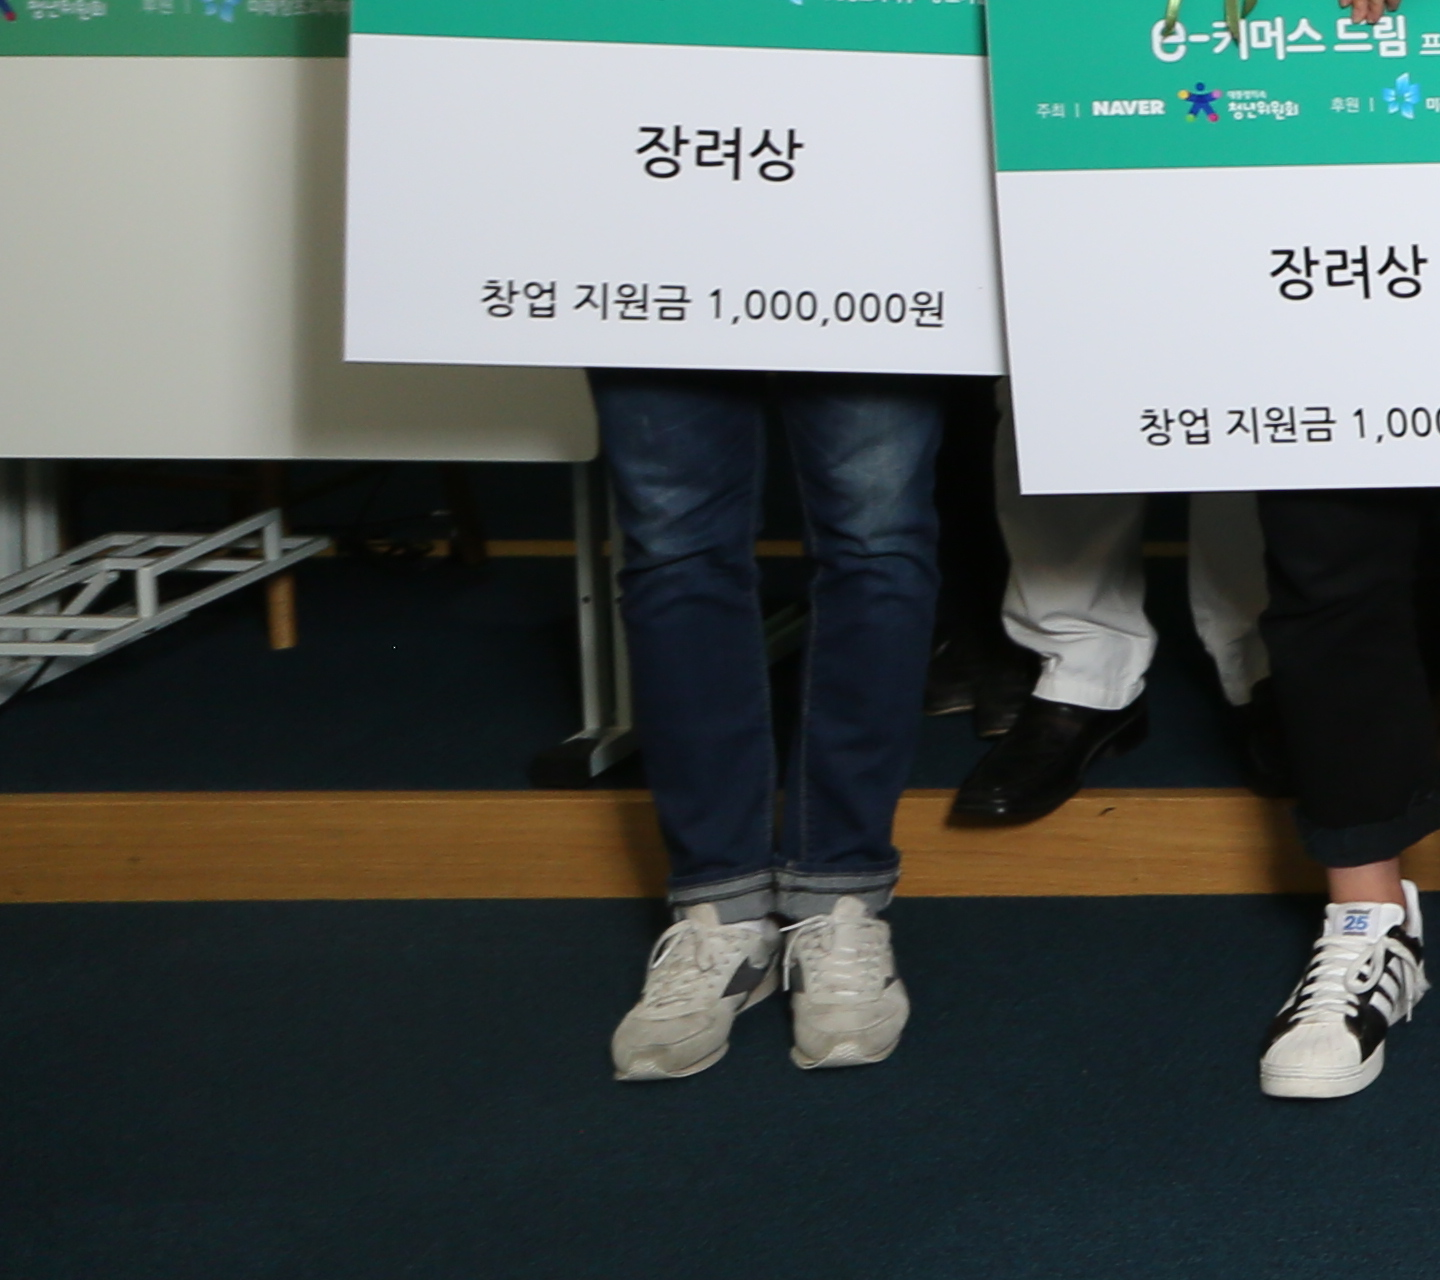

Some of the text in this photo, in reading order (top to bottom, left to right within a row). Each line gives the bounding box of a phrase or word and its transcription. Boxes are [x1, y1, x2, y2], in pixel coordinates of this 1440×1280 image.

[1151, 16, 1326, 62] e-커머스
[1333, 15, 1407, 58] 드림
[1091, 99, 1166, 117] NAVER
[635, 124, 803, 182] 장려상
[1270, 244, 1429, 301] 장려상
[480, 278, 947, 329] 창업 지원금 1,000,000원
[1139, 407, 1211, 446] 창업
[1225, 406, 1337, 445] 지원금
[1343, 915, 1369, 931] 25
